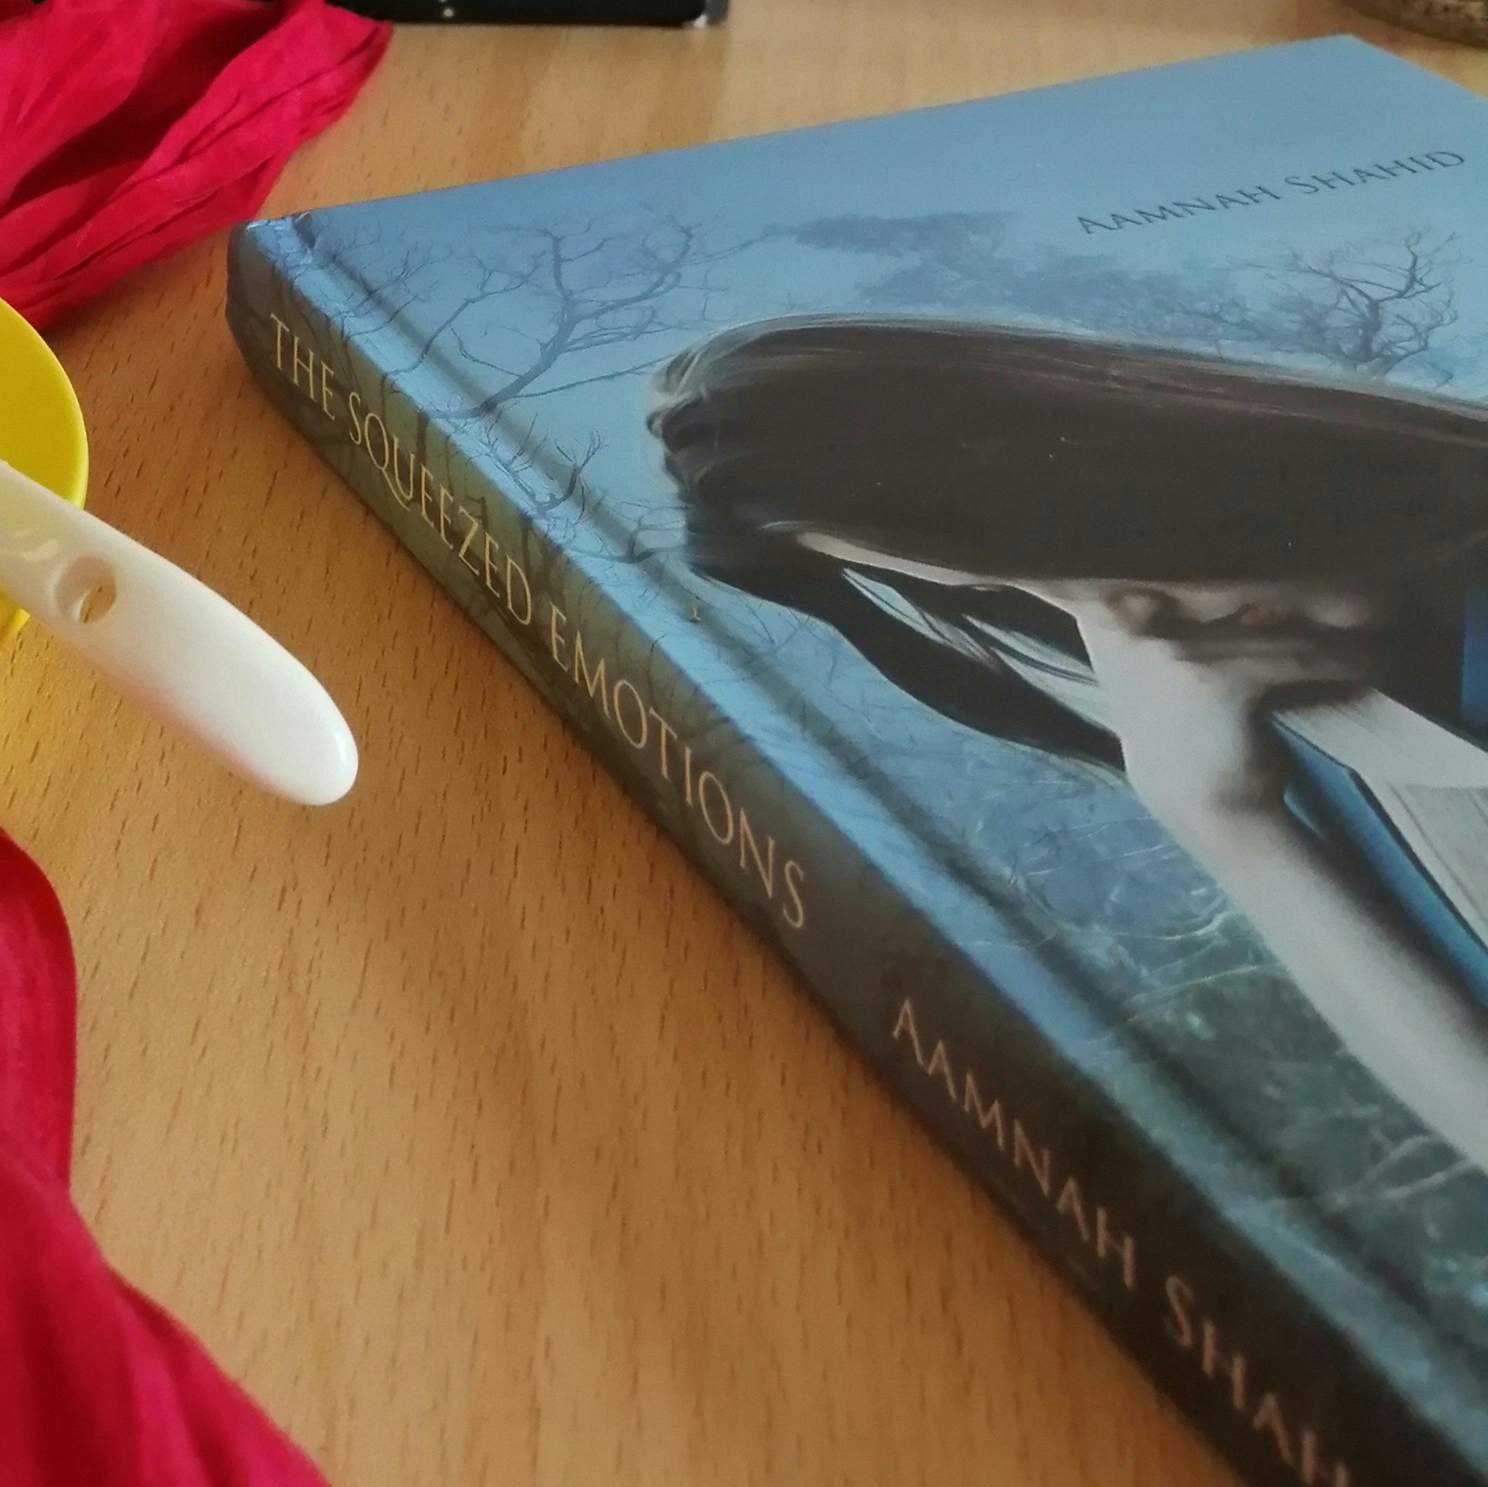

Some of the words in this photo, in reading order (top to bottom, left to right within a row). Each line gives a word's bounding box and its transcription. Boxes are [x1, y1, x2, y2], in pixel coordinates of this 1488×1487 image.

[1076, 184, 1282, 235] AAMNAH
[1283, 150, 1466, 195] SHAHID
[269, 311, 336, 422] THE
[347, 390, 534, 627] SQUEEZED
[547, 599, 806, 930] EMOTIONS
[891, 996, 1136, 1291] AAMNAH
